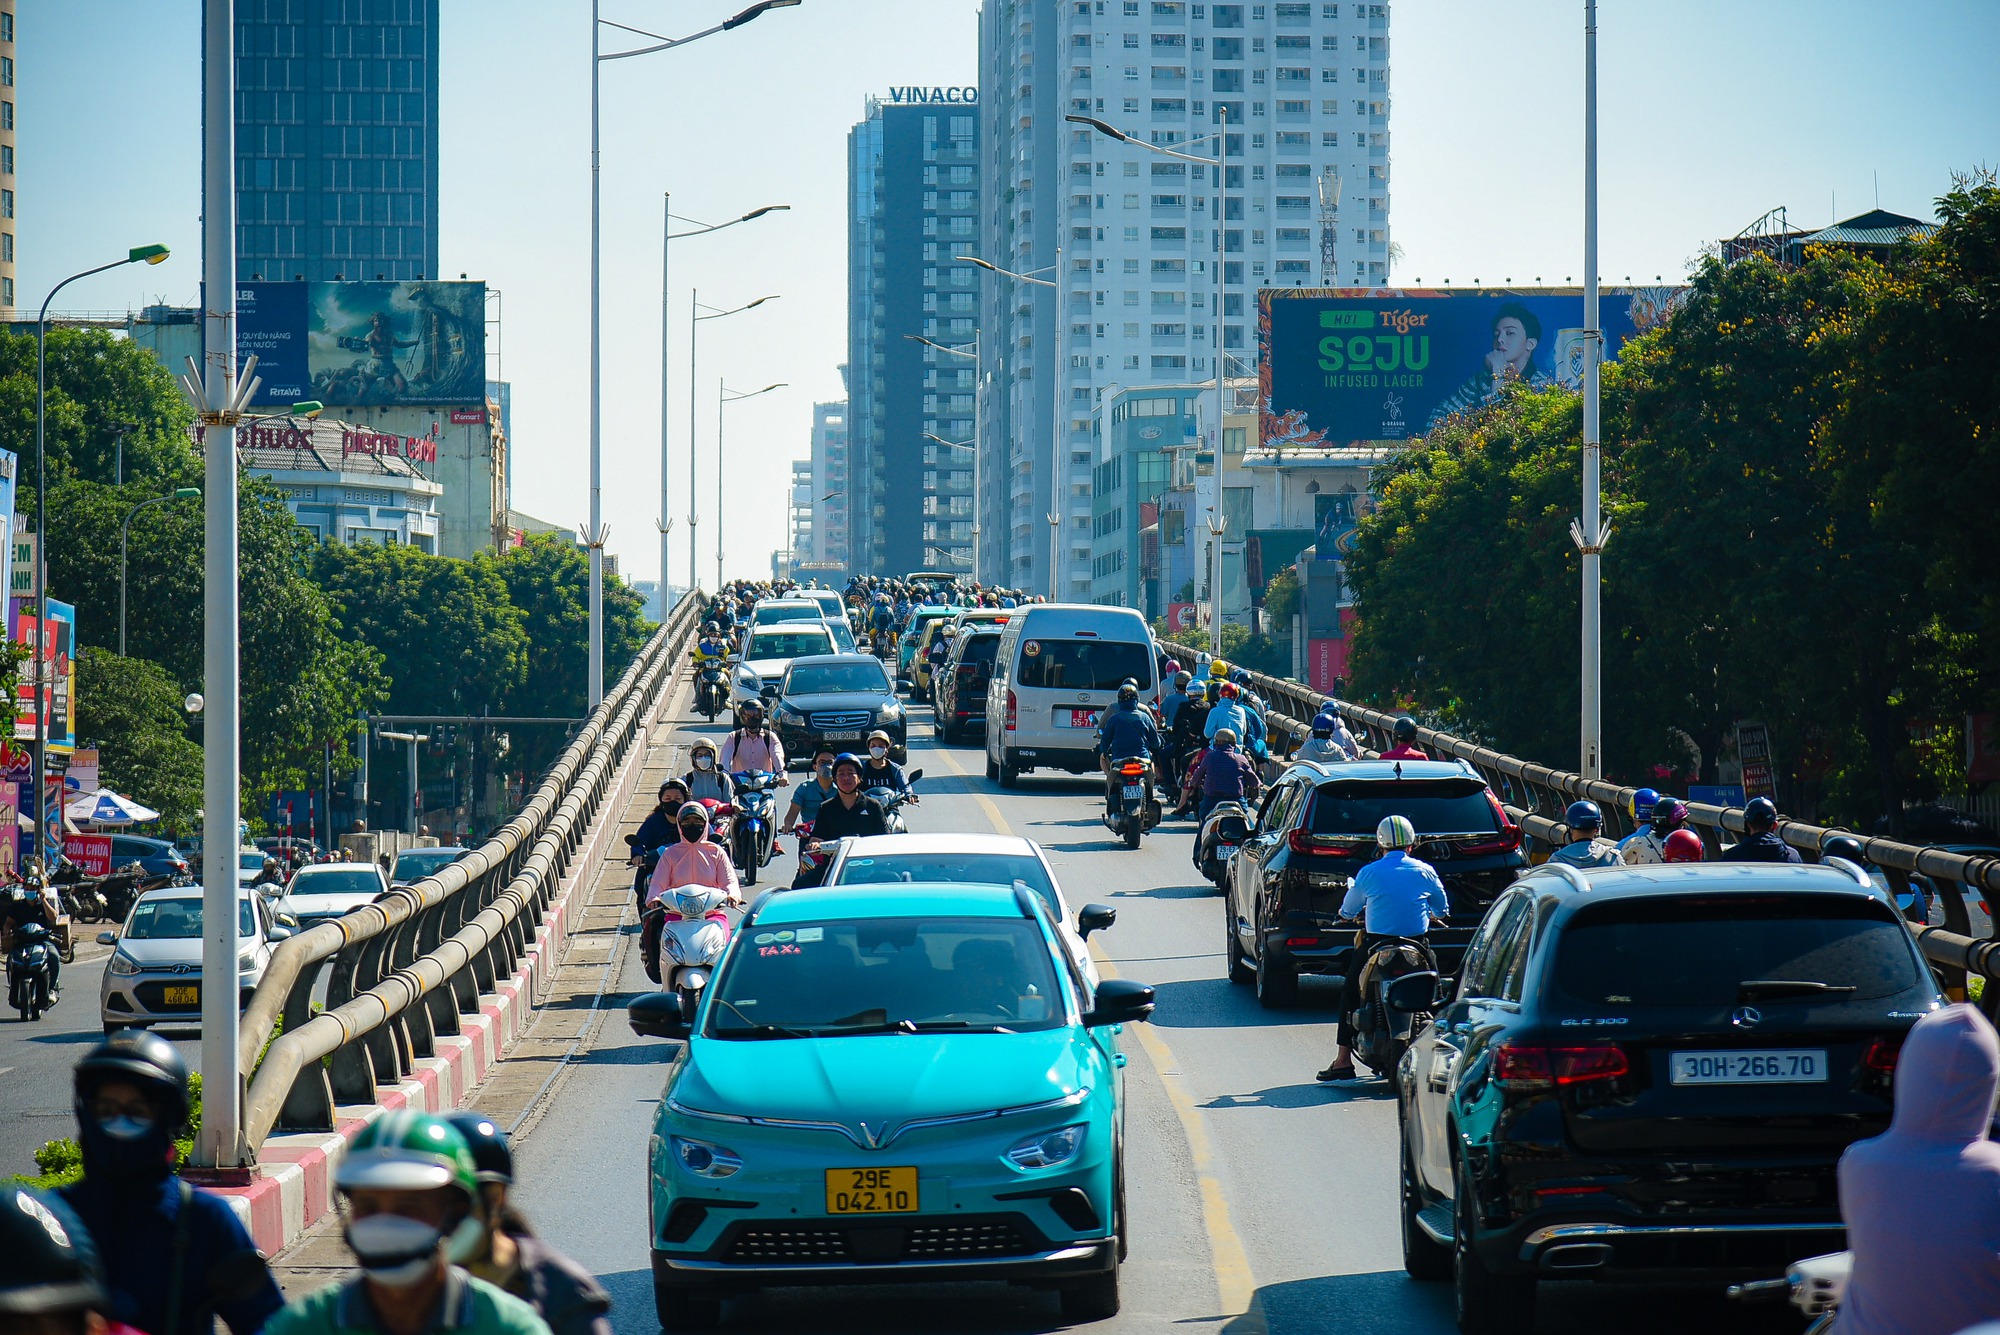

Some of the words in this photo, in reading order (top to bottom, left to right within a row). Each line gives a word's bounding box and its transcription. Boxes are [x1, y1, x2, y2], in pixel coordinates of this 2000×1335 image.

[889, 86, 978, 103] VINACO
[1379, 309, 1429, 334] Tiger
[1318, 335, 1429, 371] SOJU
[1325, 375, 1377, 387] INFUSED
[1384, 375, 1423, 387] LAGER
[343, 424, 399, 460] pierre
[1320, 642, 1328, 687] momentum
[86, 842, 109, 857] CHỮA
[1561, 1018, 1592, 1026] GLC
[1685, 1055, 1815, 1077] 30H-266.70
[851, 1170, 892, 1189] 29E
[836, 1190, 909, 1211] 042.10
